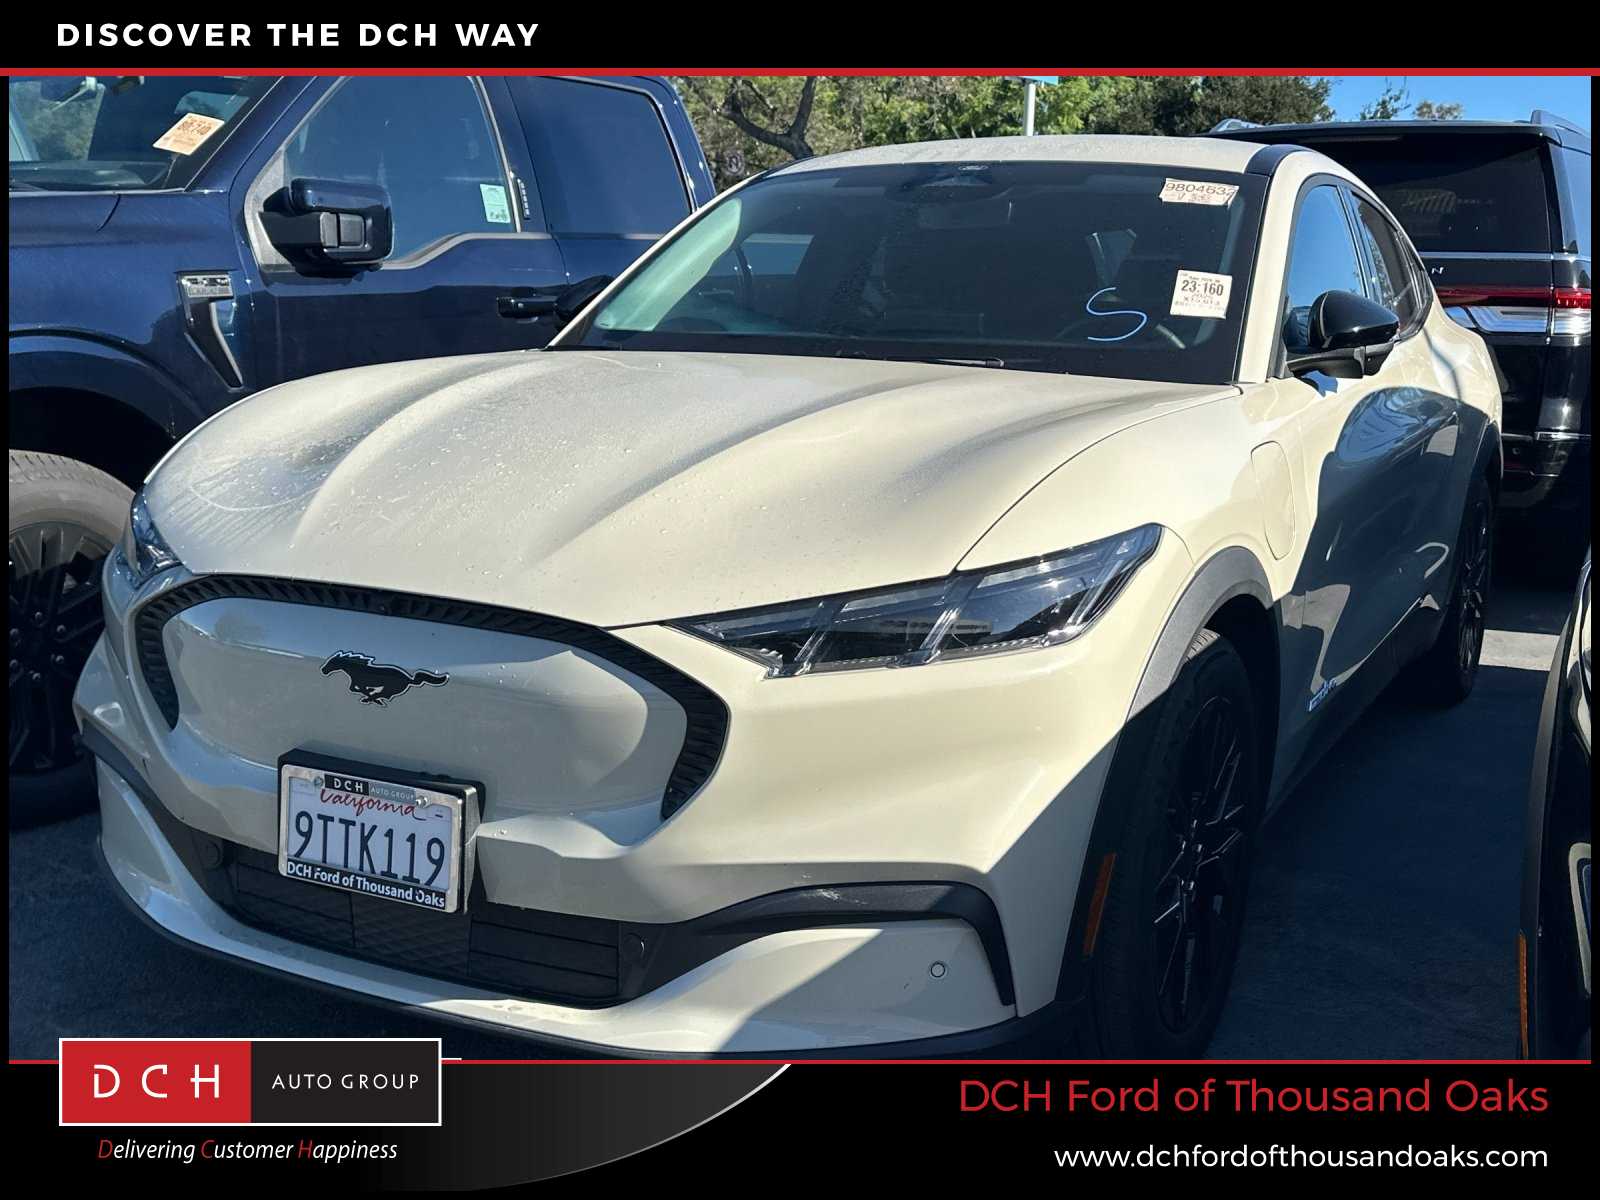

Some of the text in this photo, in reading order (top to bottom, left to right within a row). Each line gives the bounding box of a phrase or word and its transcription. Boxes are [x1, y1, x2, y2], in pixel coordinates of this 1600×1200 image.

[1181, 279, 1224, 297] 23:160
[333, 778, 364, 793] DCH
[294, 810, 446, 886] 9TTK119
[287, 861, 446, 908] DCH Ford of Thousand Oaks
